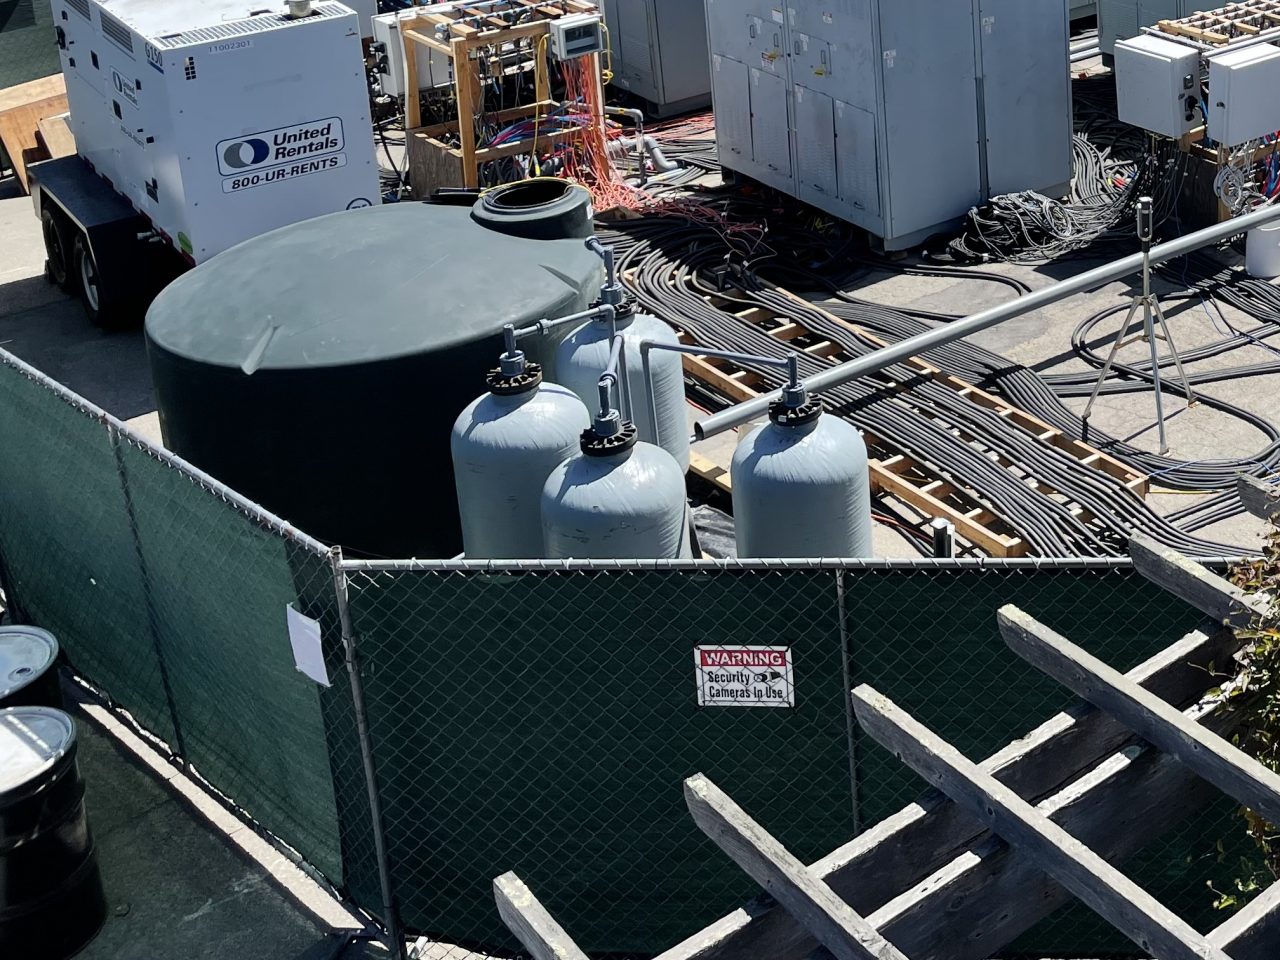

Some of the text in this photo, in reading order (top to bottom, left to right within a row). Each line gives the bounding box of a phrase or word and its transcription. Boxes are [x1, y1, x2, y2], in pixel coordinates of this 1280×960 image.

[145, 41, 163, 67] G150
[273, 123, 332, 146] United
[274, 137, 339, 161] Rentals
[231, 156, 339, 190] 800-UR-RENTS
[705, 652, 782, 665] WARNING
[707, 670, 750, 685] Security
[709, 685, 783, 699] Cameras In Use
